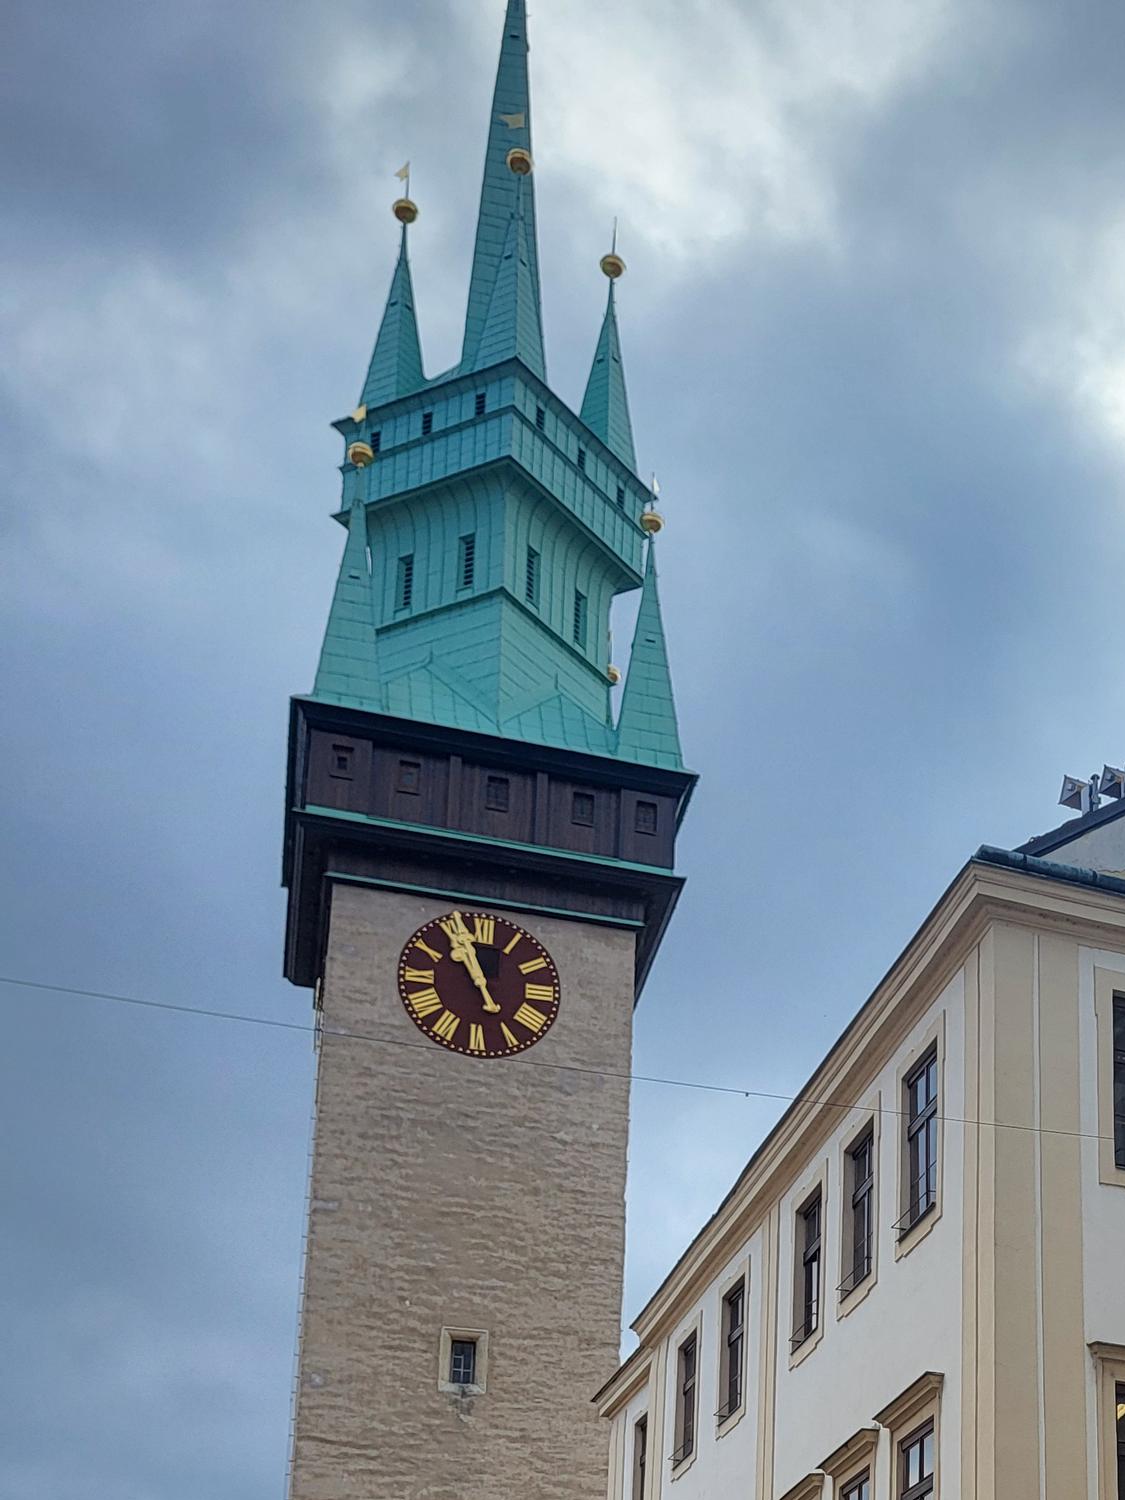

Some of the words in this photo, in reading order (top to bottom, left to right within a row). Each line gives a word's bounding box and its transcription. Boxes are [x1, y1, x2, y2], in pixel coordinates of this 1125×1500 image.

[473, 917, 495, 945] XII
[414, 938, 443, 962] X
[404, 966, 435, 984] IX
[518, 956, 548, 975] II
[408, 987, 444, 1018] VIII
[525, 983, 554, 1001] III
[432, 1010, 461, 1041] VII
[469, 1023, 486, 1051] VI
[500, 1022, 520, 1048] V
